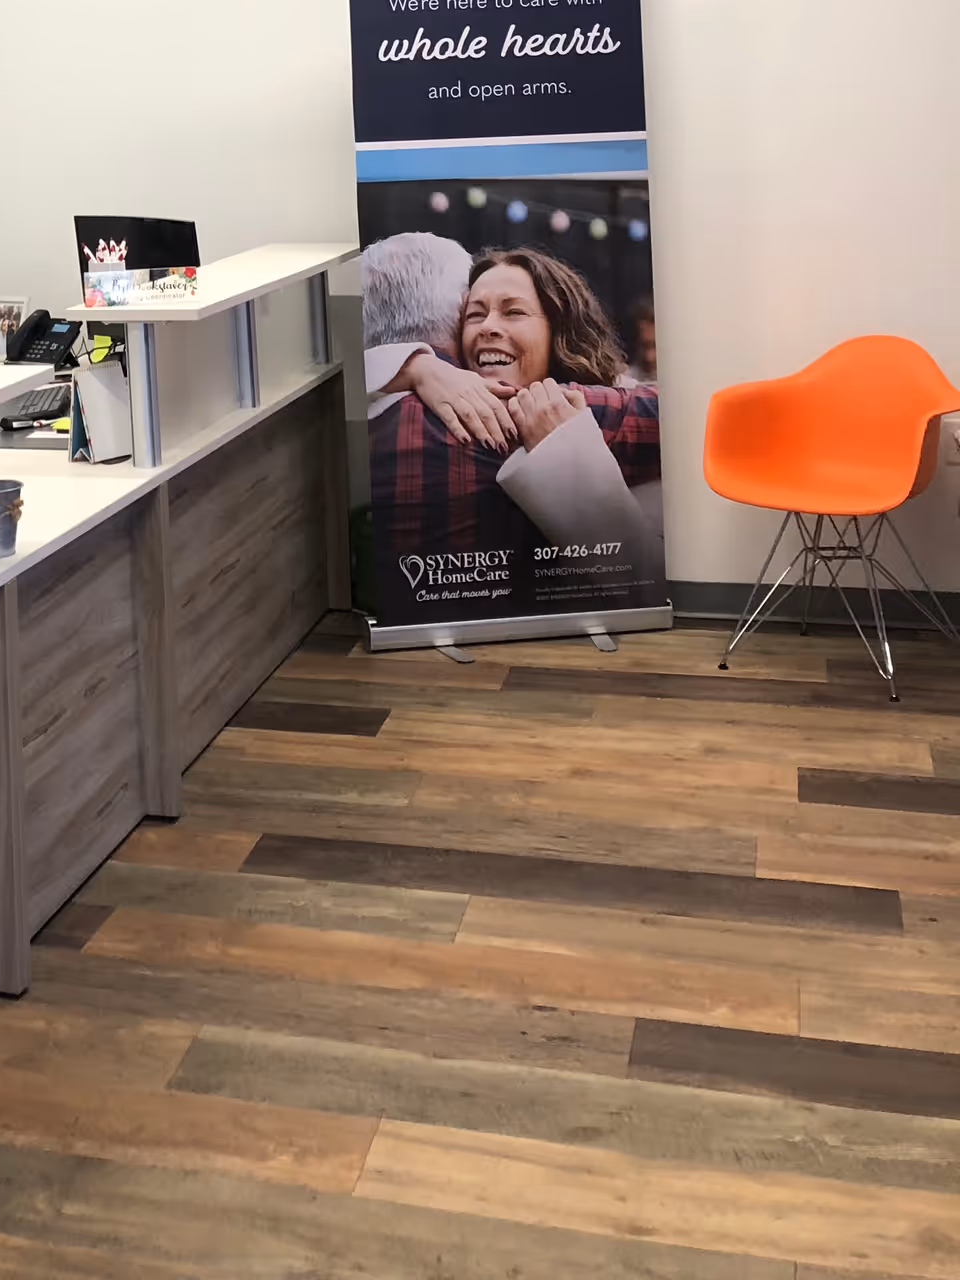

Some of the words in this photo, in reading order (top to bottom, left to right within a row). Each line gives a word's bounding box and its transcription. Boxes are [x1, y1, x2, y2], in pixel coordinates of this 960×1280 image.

[378, 25, 487, 62] whole
[500, 23, 621, 57] hearts
[428, 80, 461, 99] and
[468, 83, 515, 101] open
[522, 81, 572, 96] arms.
[425, 550, 511, 570] SYNERGY
[533, 542, 622, 560] 307-426-4177
[427, 567, 510, 585] HomeCare
[534, 564, 633, 578] SYNERGYHomeCare.com
[416, 589, 440, 602] Care
[441, 590, 460, 600] that
[461, 589, 490, 598] moves
